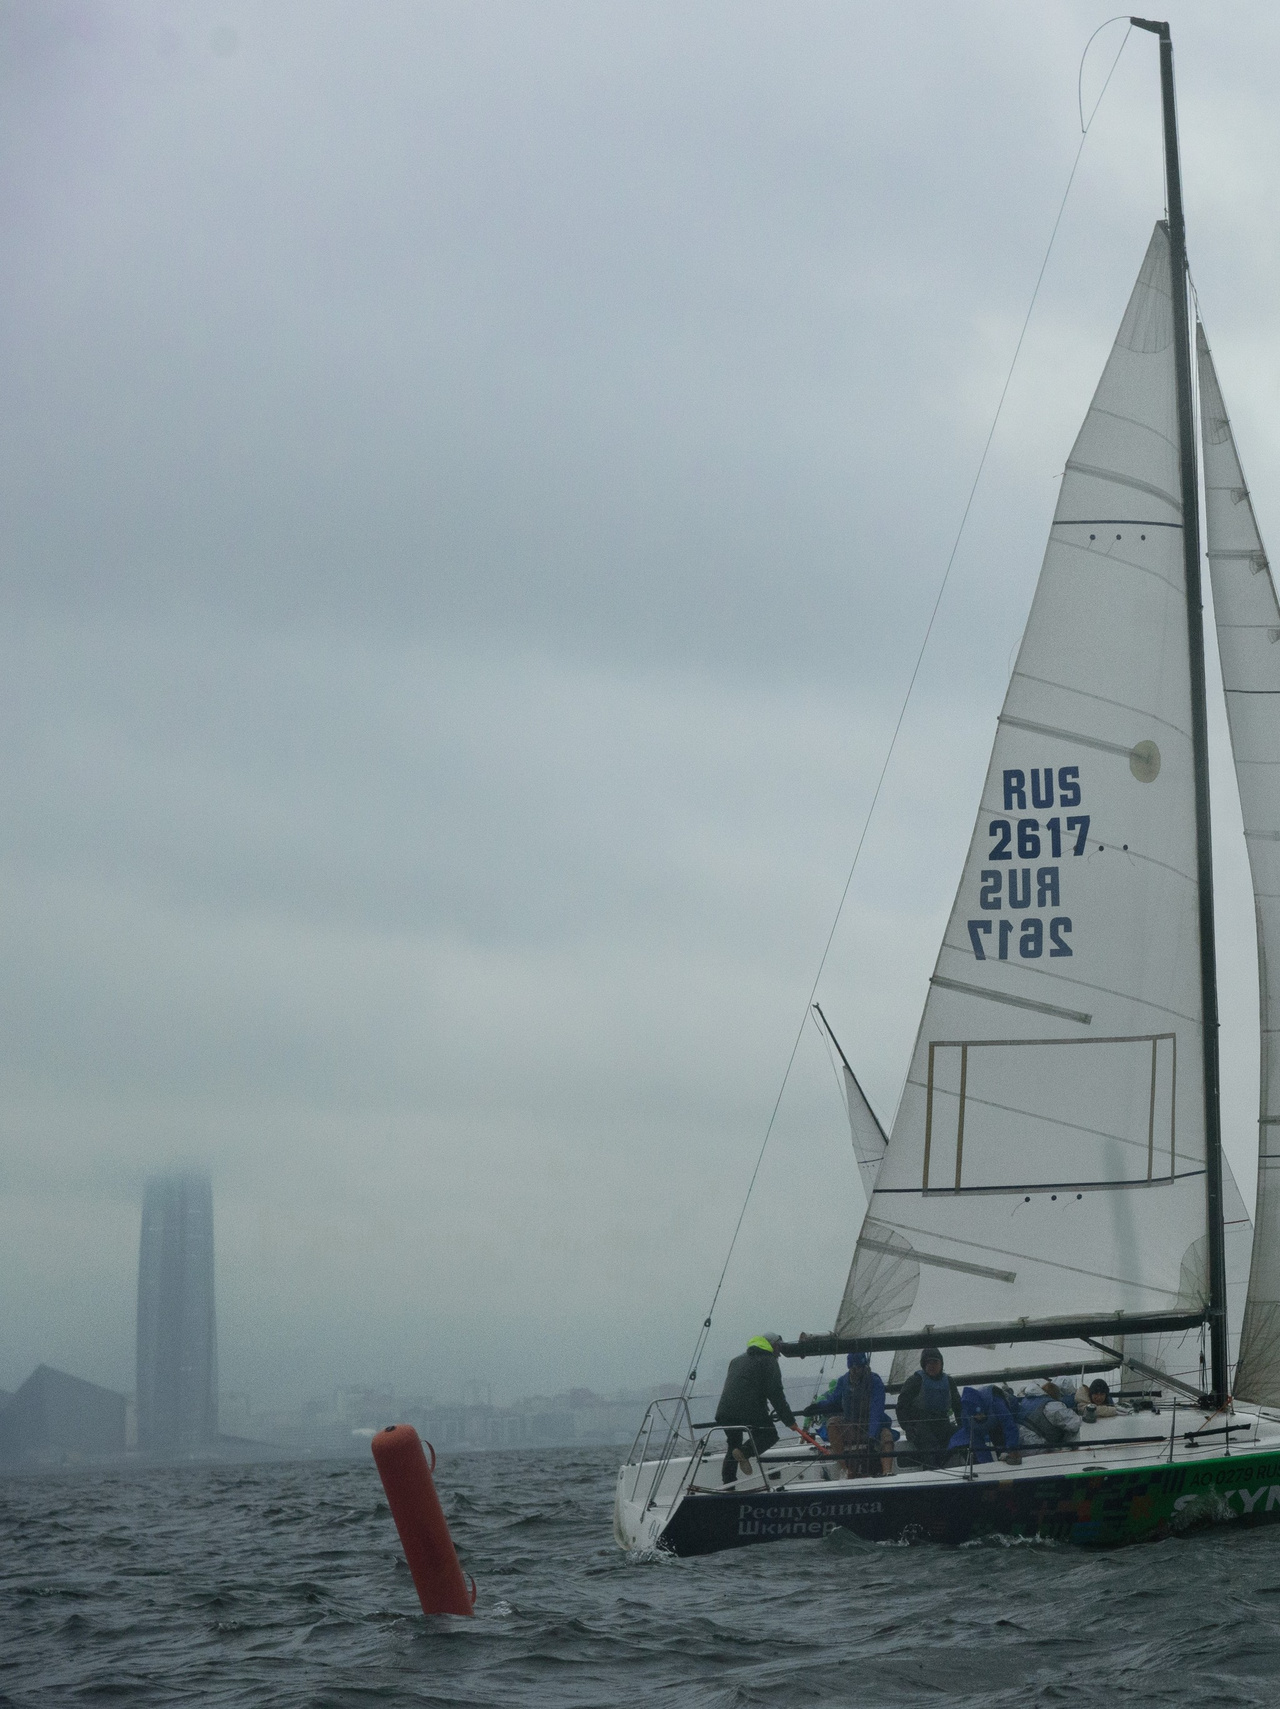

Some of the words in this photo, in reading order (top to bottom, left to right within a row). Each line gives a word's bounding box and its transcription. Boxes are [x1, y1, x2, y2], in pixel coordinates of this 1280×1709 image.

[1003, 766, 1081, 810] RUS
[989, 815, 1091, 860] 2617
[1215, 1467, 1254, 1485] 0279
[738, 1501, 884, 1521] Республика
[738, 1521, 837, 1537] Шкипер
